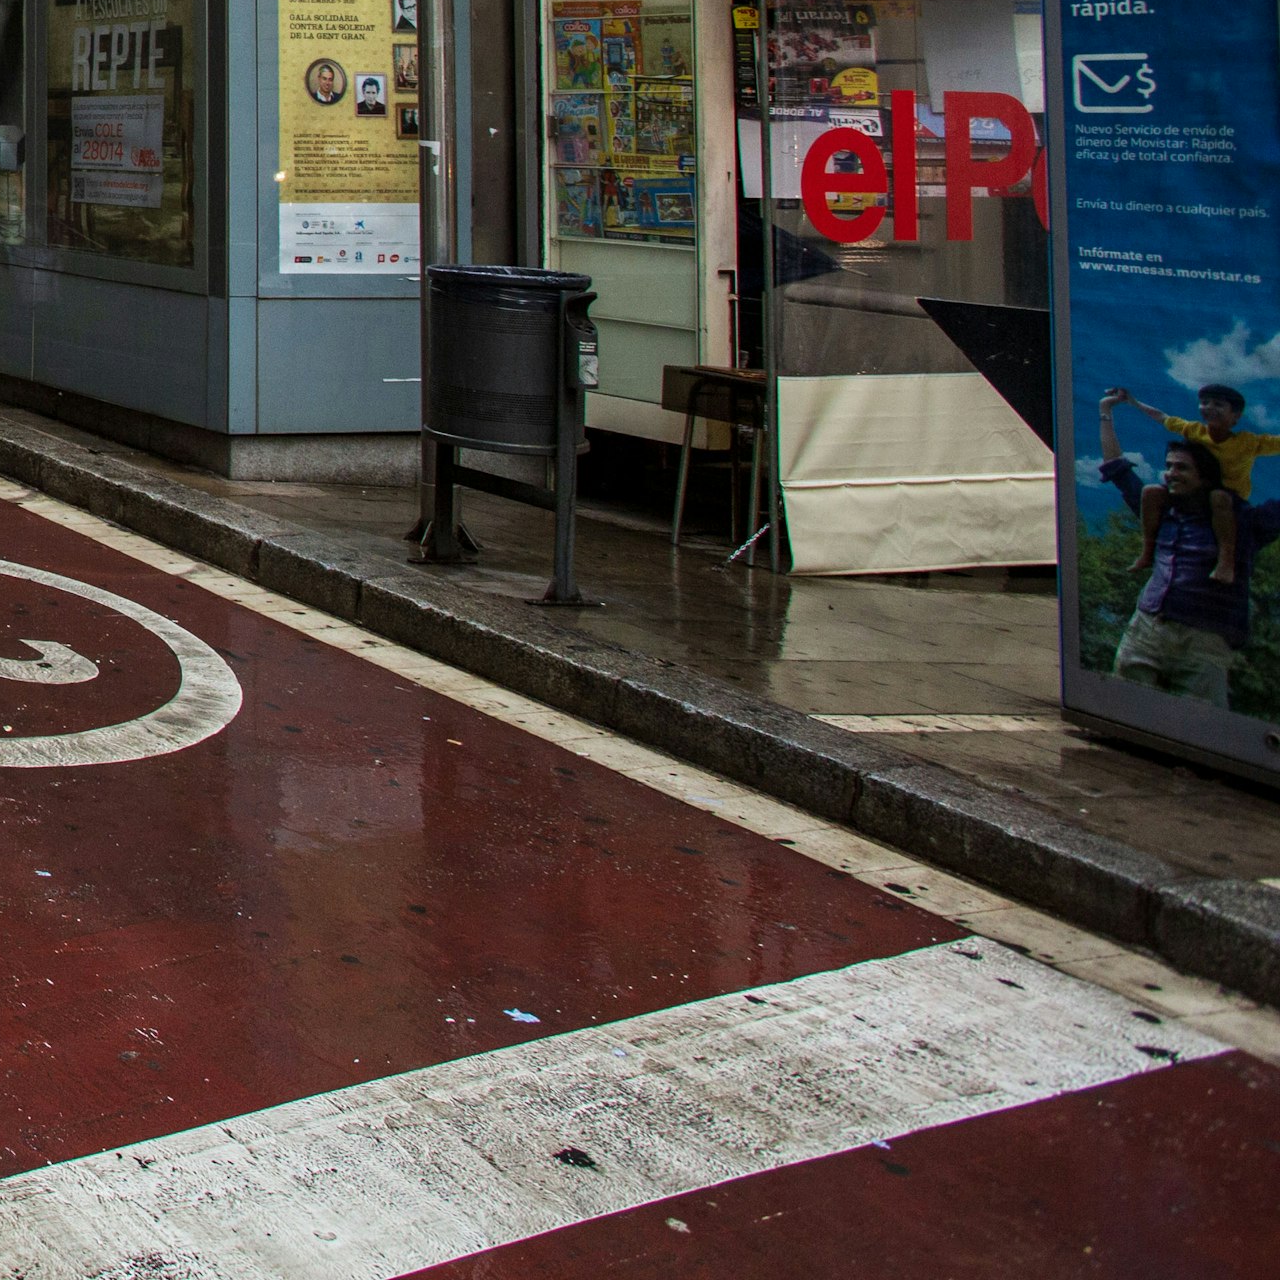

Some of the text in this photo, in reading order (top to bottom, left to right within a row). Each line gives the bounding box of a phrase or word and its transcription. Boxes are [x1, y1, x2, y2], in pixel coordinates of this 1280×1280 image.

[289, 13, 312, 21] GALA
[289, 22, 376, 32] CONTRA LA SOLEDAT
[290, 32, 302, 40] DE
[303, 32, 315, 40] LA
[316, 32, 340, 40] GENT
[71, 18, 167, 92] REPTE
[95, 123, 124, 138] COLE
[1075, 123, 1113, 136] Nuevo
[1114, 123, 1163, 137] Servicio
[1164, 124, 1181, 137] de
[1219, 124, 1235, 137] de
[1075, 135, 1110, 149] dinero
[1111, 136, 1128, 149] de
[1130, 136, 1190, 150] Movistar:
[82, 140, 124, 161] 28014
[1075, 148, 1235, 164] eficaz y de total confianza.
[1076, 198, 1108, 210] Envía
[1110, 200, 1123, 211] tu
[1125, 200, 1163, 214] dinero
[1165, 204, 1174, 214] a
[1175, 202, 1236, 219] cualquier
[1078, 246, 1164, 264] Infórmate en
[1078, 261, 1262, 284] www.remesas.movistar.es
